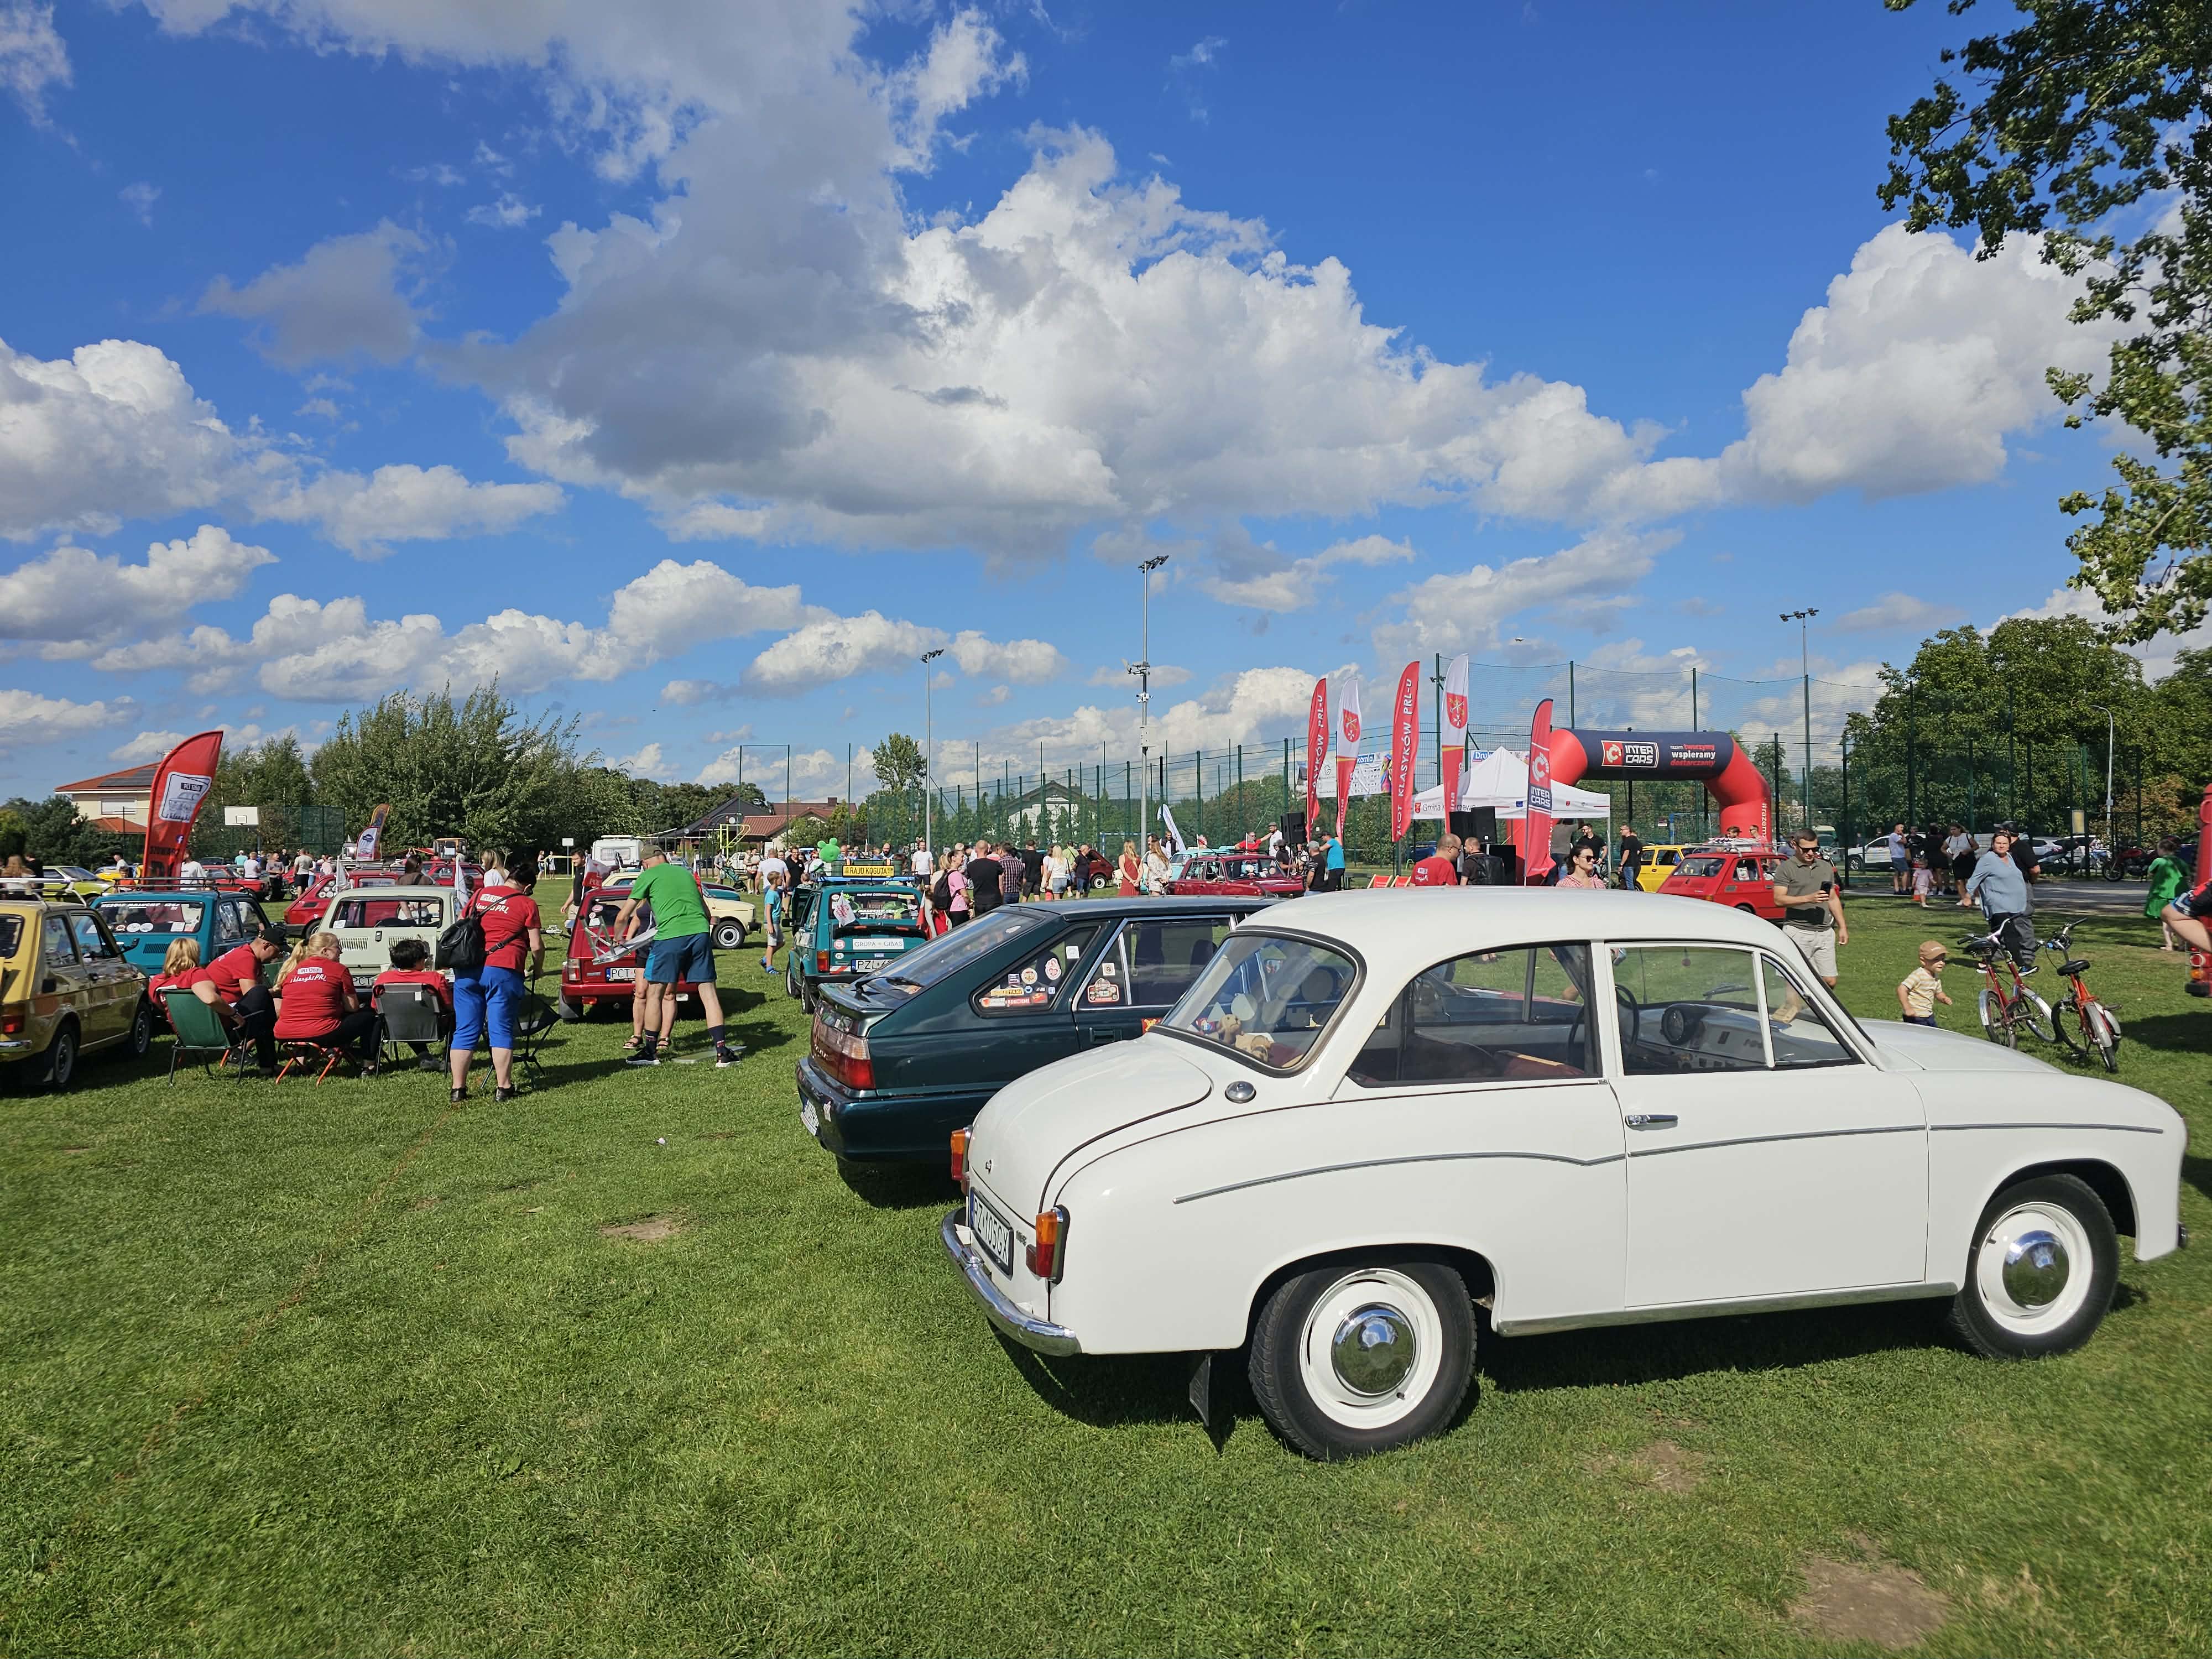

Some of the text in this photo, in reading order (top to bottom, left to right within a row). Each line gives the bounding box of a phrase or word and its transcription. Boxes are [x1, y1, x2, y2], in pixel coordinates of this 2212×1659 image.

[1403, 679, 1413, 715] PRL-U
[1625, 745, 1653, 755] INTER
[1671, 750, 1716, 760] wspieramy
[1398, 722, 1412, 797] KLASYKÓW
[1625, 754, 1653, 764] CARS
[1531, 786, 1550, 799] INTER
[1531, 795, 1551, 807] CARS
[865, 867, 887, 875] KOGUTA
[857, 961, 877, 969] PZL
[314, 973, 327, 982] PRL
[611, 969, 630, 978] PCT
[352, 977, 372, 985] PCT
[974, 1197, 1009, 1265] PZ 105GX
